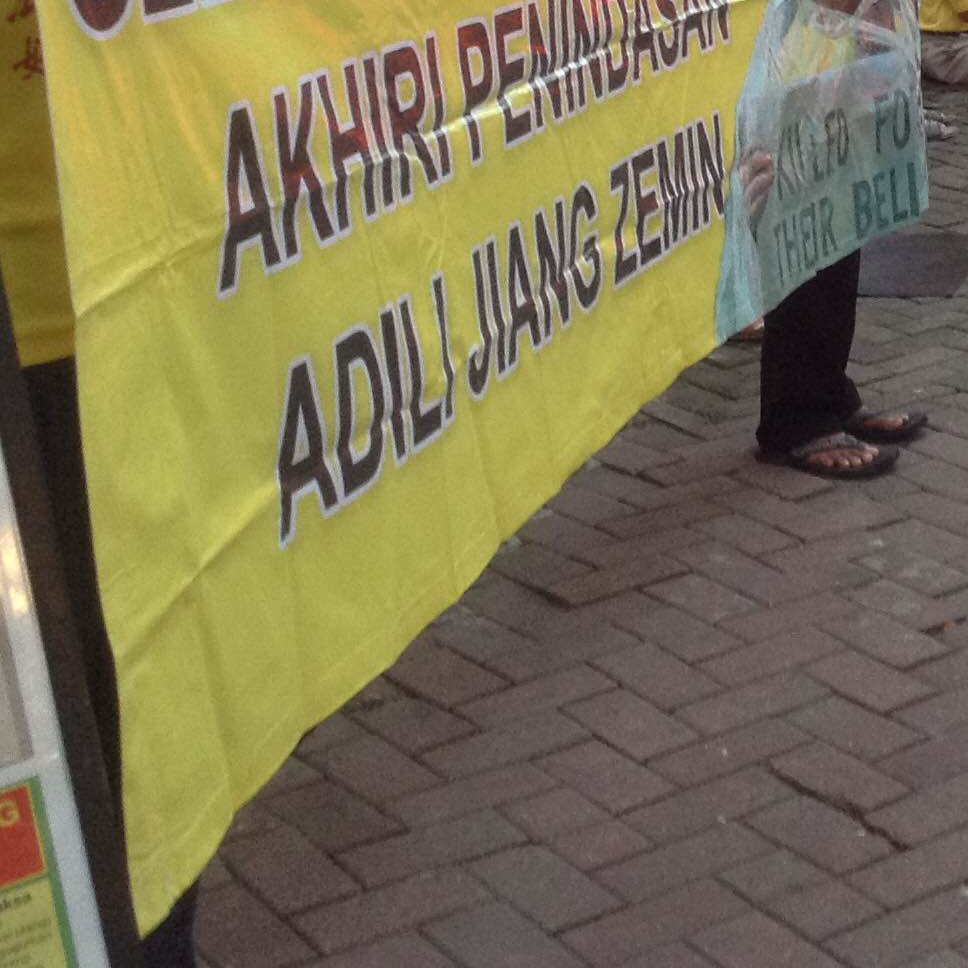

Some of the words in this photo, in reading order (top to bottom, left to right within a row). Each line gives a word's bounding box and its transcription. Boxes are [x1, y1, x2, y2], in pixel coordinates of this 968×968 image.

[216, 32, 454, 299] AKHIRI
[277, 270, 457, 548] ADILI
[467, 180, 604, 399] JIANG
[608, 111, 727, 287] ZEMIN
